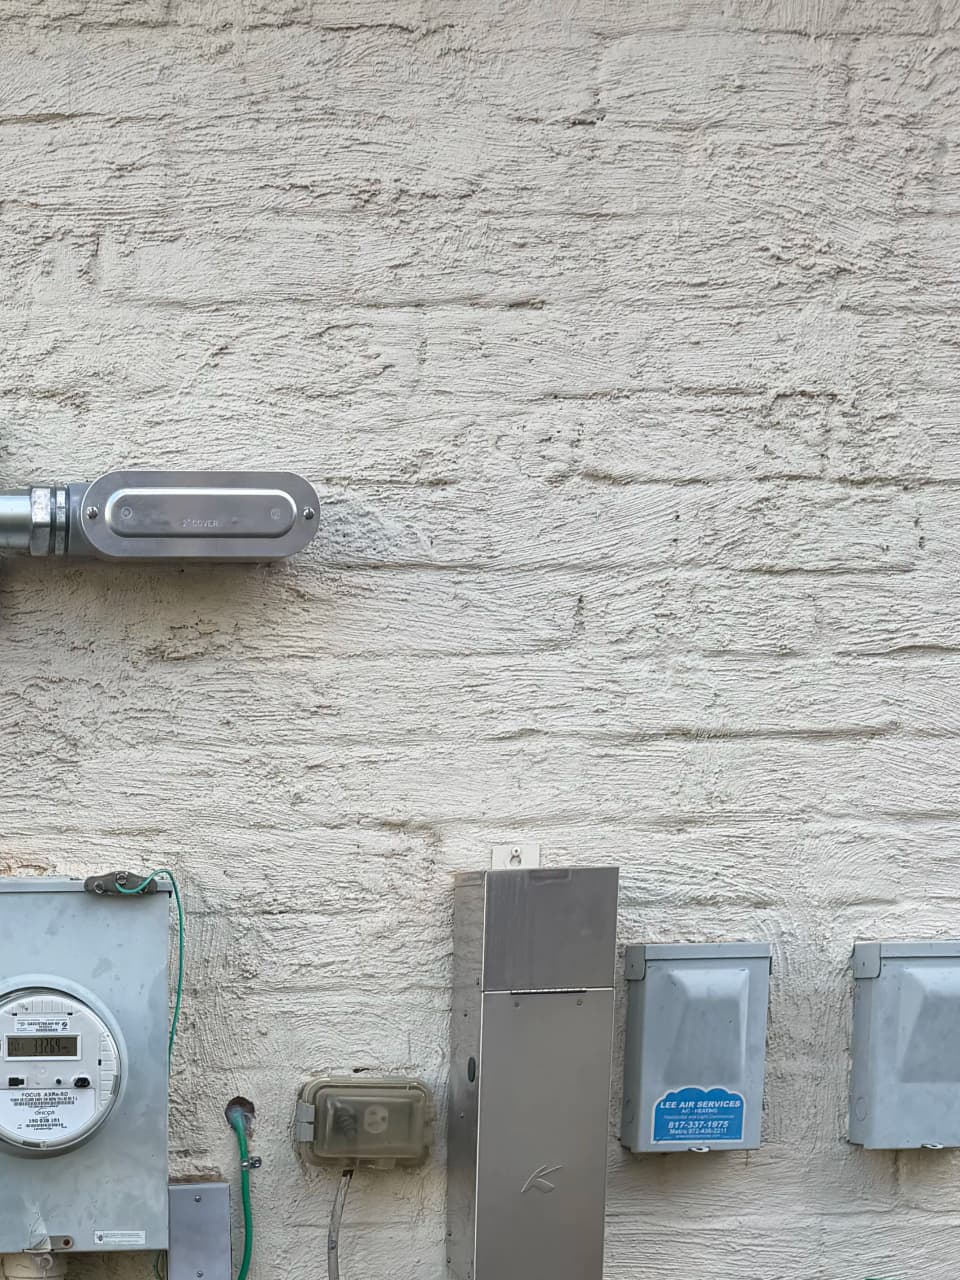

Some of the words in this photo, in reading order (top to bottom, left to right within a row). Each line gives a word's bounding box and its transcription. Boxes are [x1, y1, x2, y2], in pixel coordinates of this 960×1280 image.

[660, 1101, 677, 1109] LEE
[696, 1100, 741, 1108] SERVICES
[668, 1121, 729, 1129] 817-337-1975
